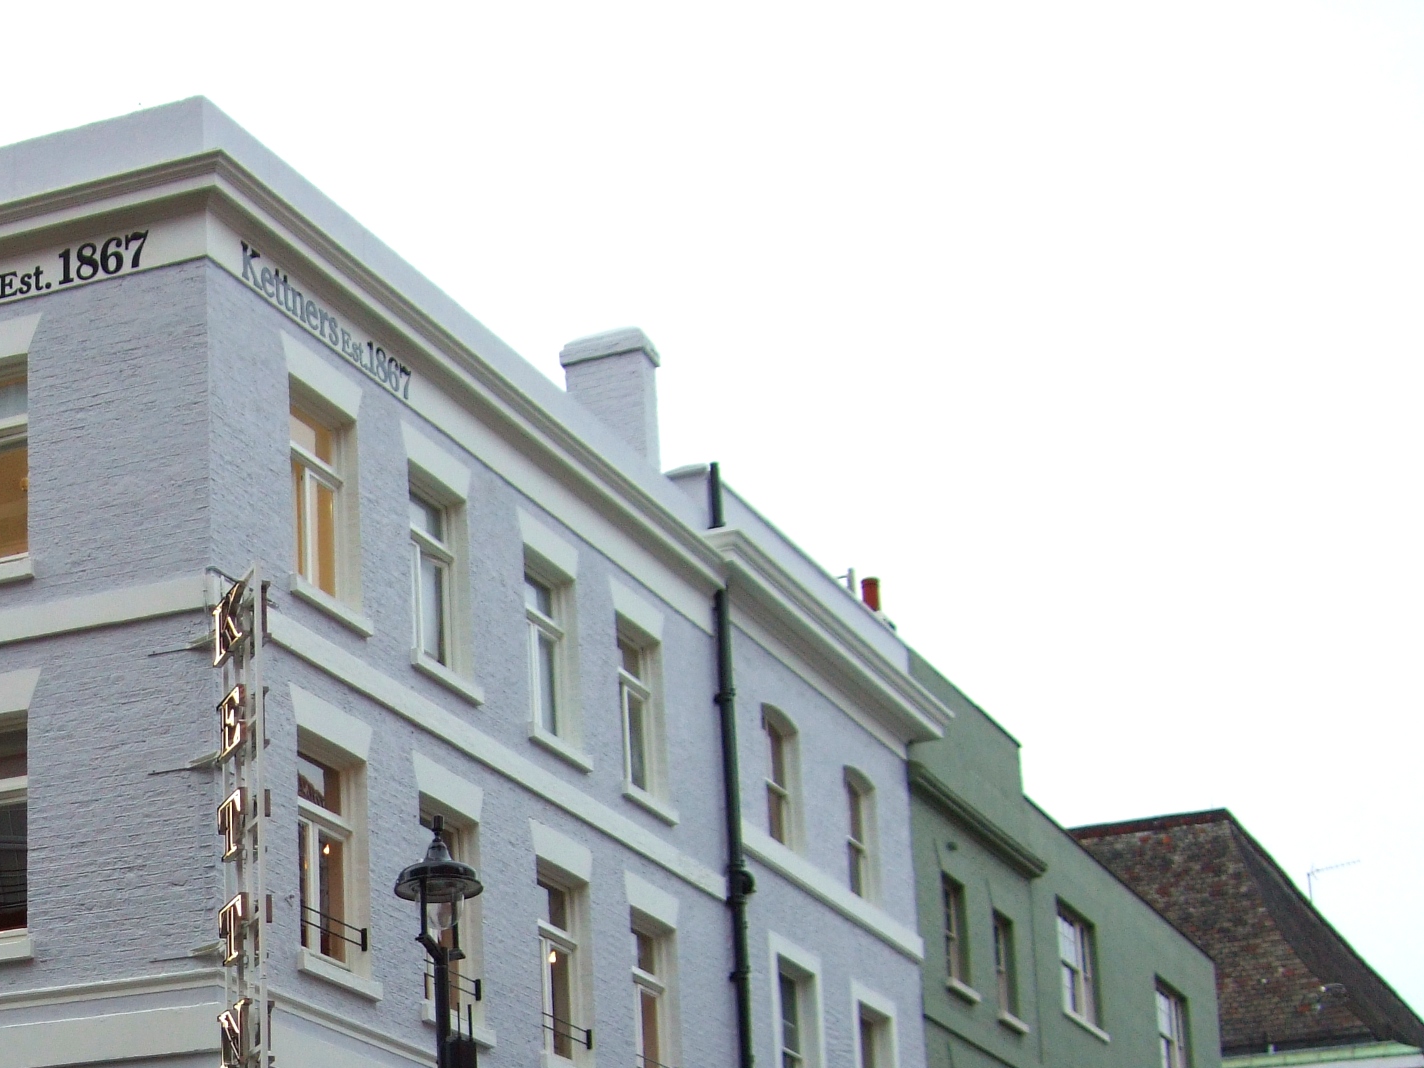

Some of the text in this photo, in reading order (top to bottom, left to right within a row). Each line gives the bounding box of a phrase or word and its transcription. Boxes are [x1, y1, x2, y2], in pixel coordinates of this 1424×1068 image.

[58, 229, 150, 286] 1867
[240, 239, 339, 347] Kettners
[367, 340, 412, 400] 1867
